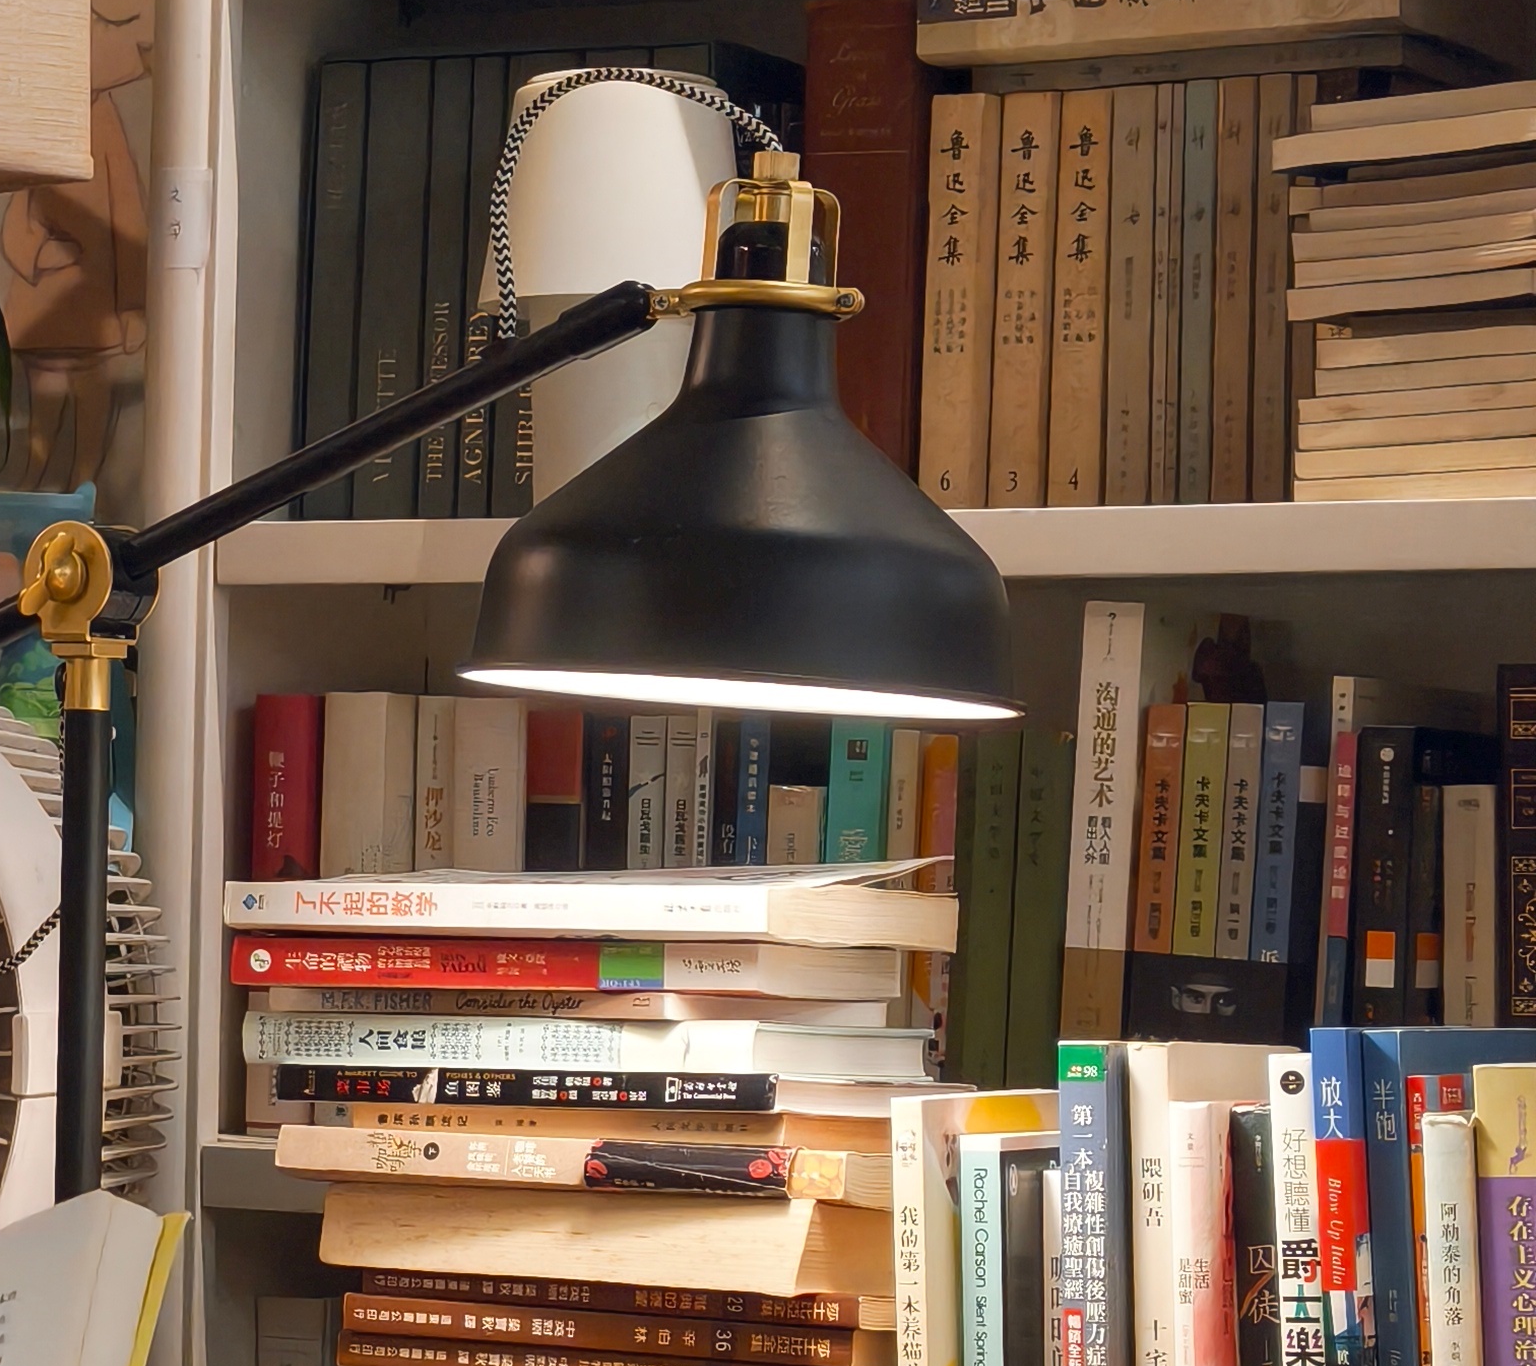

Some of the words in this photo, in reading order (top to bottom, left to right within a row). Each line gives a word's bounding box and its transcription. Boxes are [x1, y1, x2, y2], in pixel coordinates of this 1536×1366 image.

[466, 308, 489, 362] REY
[425, 438, 444, 482] THE
[464, 408, 485, 485] AGNE
[939, 470, 952, 492] 6
[1005, 470, 1018, 492] 3
[1068, 470, 1080, 492] 4
[1089, 682, 1119, 808] 沟通的艺术
[295, 891, 438, 916] 了不起的数学
[374, 992, 433, 1011] FISHER
[455, 992, 517, 1011] Consider
[518, 995, 538, 1010] the
[542, 992, 585, 1016] Oyster
[1083, 1065, 1098, 1078] 98
[445, 1081, 501, 1098] 鱼图鉴
[1320, 1076, 1343, 1140] 放大
[1373, 1079, 1397, 1141] 半饱
[1071, 1103, 1094, 1169] 第一本
[973, 1168, 989, 1224] Rachel
[1141, 1157, 1164, 1228] 隈研吾
[1281, 1127, 1311, 1234] 好想聽懂
[1327, 1177, 1343, 1216] Blow
[1063, 1171, 1085, 1301] 自我療癒聖經
[1328, 1219, 1344, 1241] Up
[974, 1228, 989, 1288] Carson
[1194, 1258, 1211, 1290] 生活
[1440, 1203, 1464, 1326] 阿勒泰的角落
[1178, 1258, 1193, 1305] 是甜蜜
[1248, 1246, 1280, 1324] 囚徒
[726, 1297, 743, 1312] 29
[974, 1295, 988, 1330] Silent
[481, 1316, 520, 1332] 梁實秋
[531, 1318, 575, 1338] 中英對照
[634, 1326, 696, 1347] 辛伯林
[715, 1330, 732, 1351] 36
[750, 1333, 831, 1358] 莎士比亞全集
